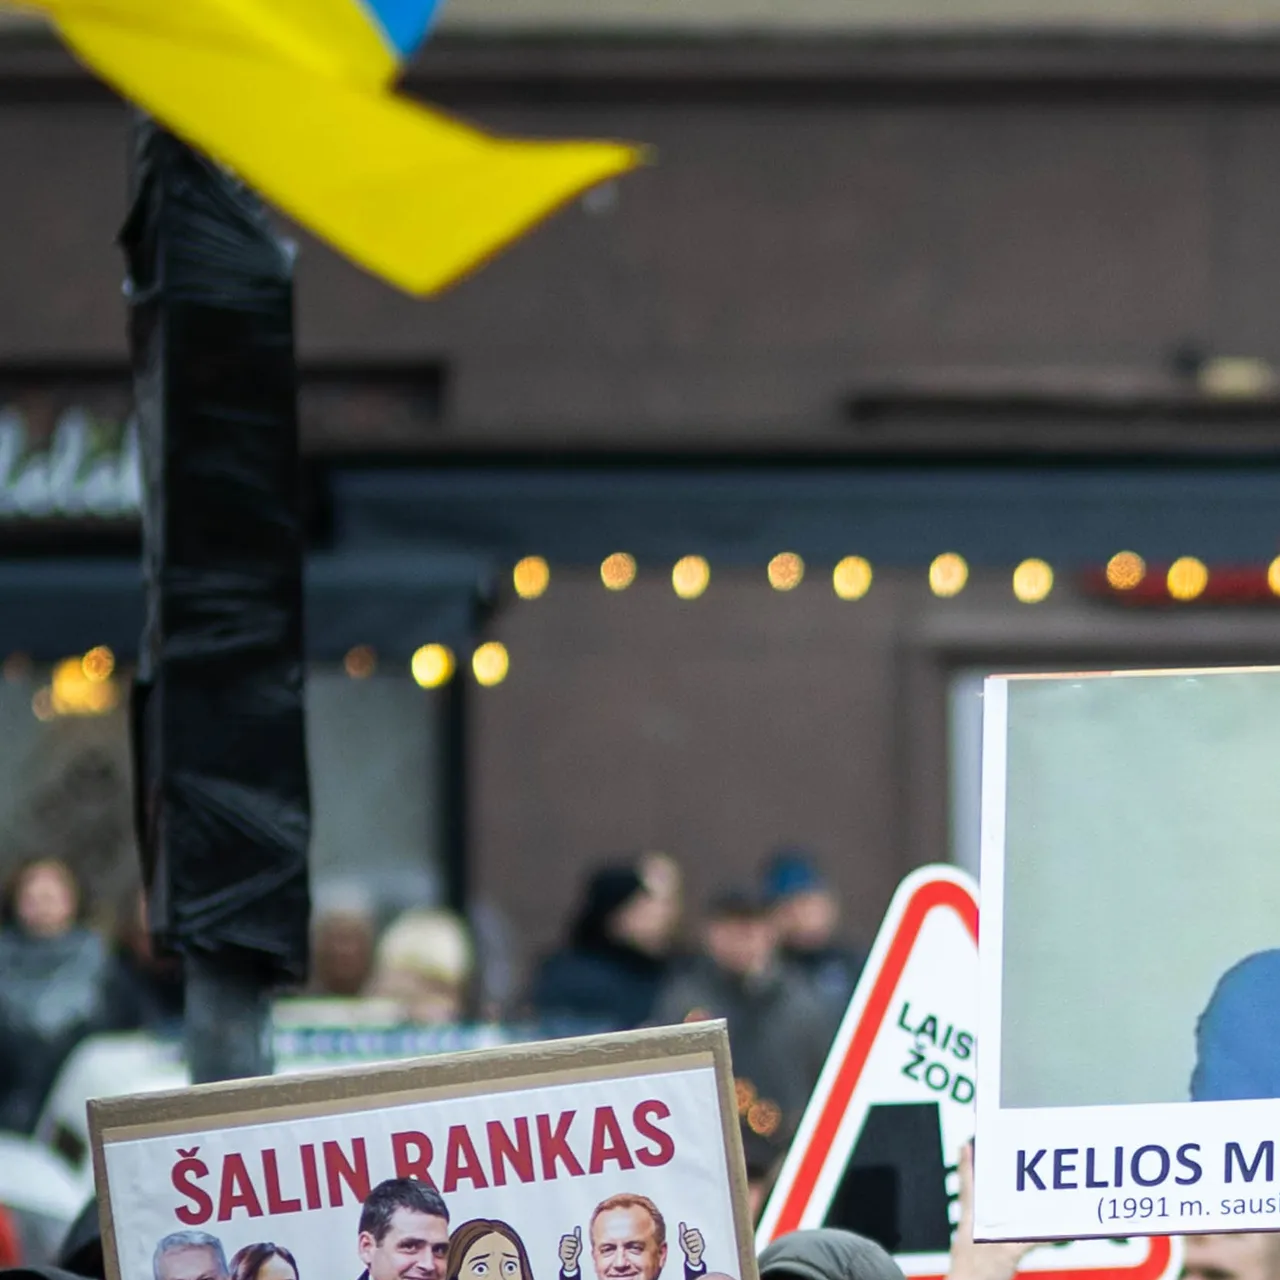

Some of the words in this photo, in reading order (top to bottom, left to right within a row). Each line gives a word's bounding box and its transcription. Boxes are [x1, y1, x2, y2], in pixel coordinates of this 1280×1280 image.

[170, 1137, 371, 1227] ŠALIN
[390, 1098, 676, 1196] RANKAS
[1016, 1142, 1203, 1192] KELIOS
[1096, 1197, 1170, 1224] (1991
[1180, 1200, 1211, 1217] m.
